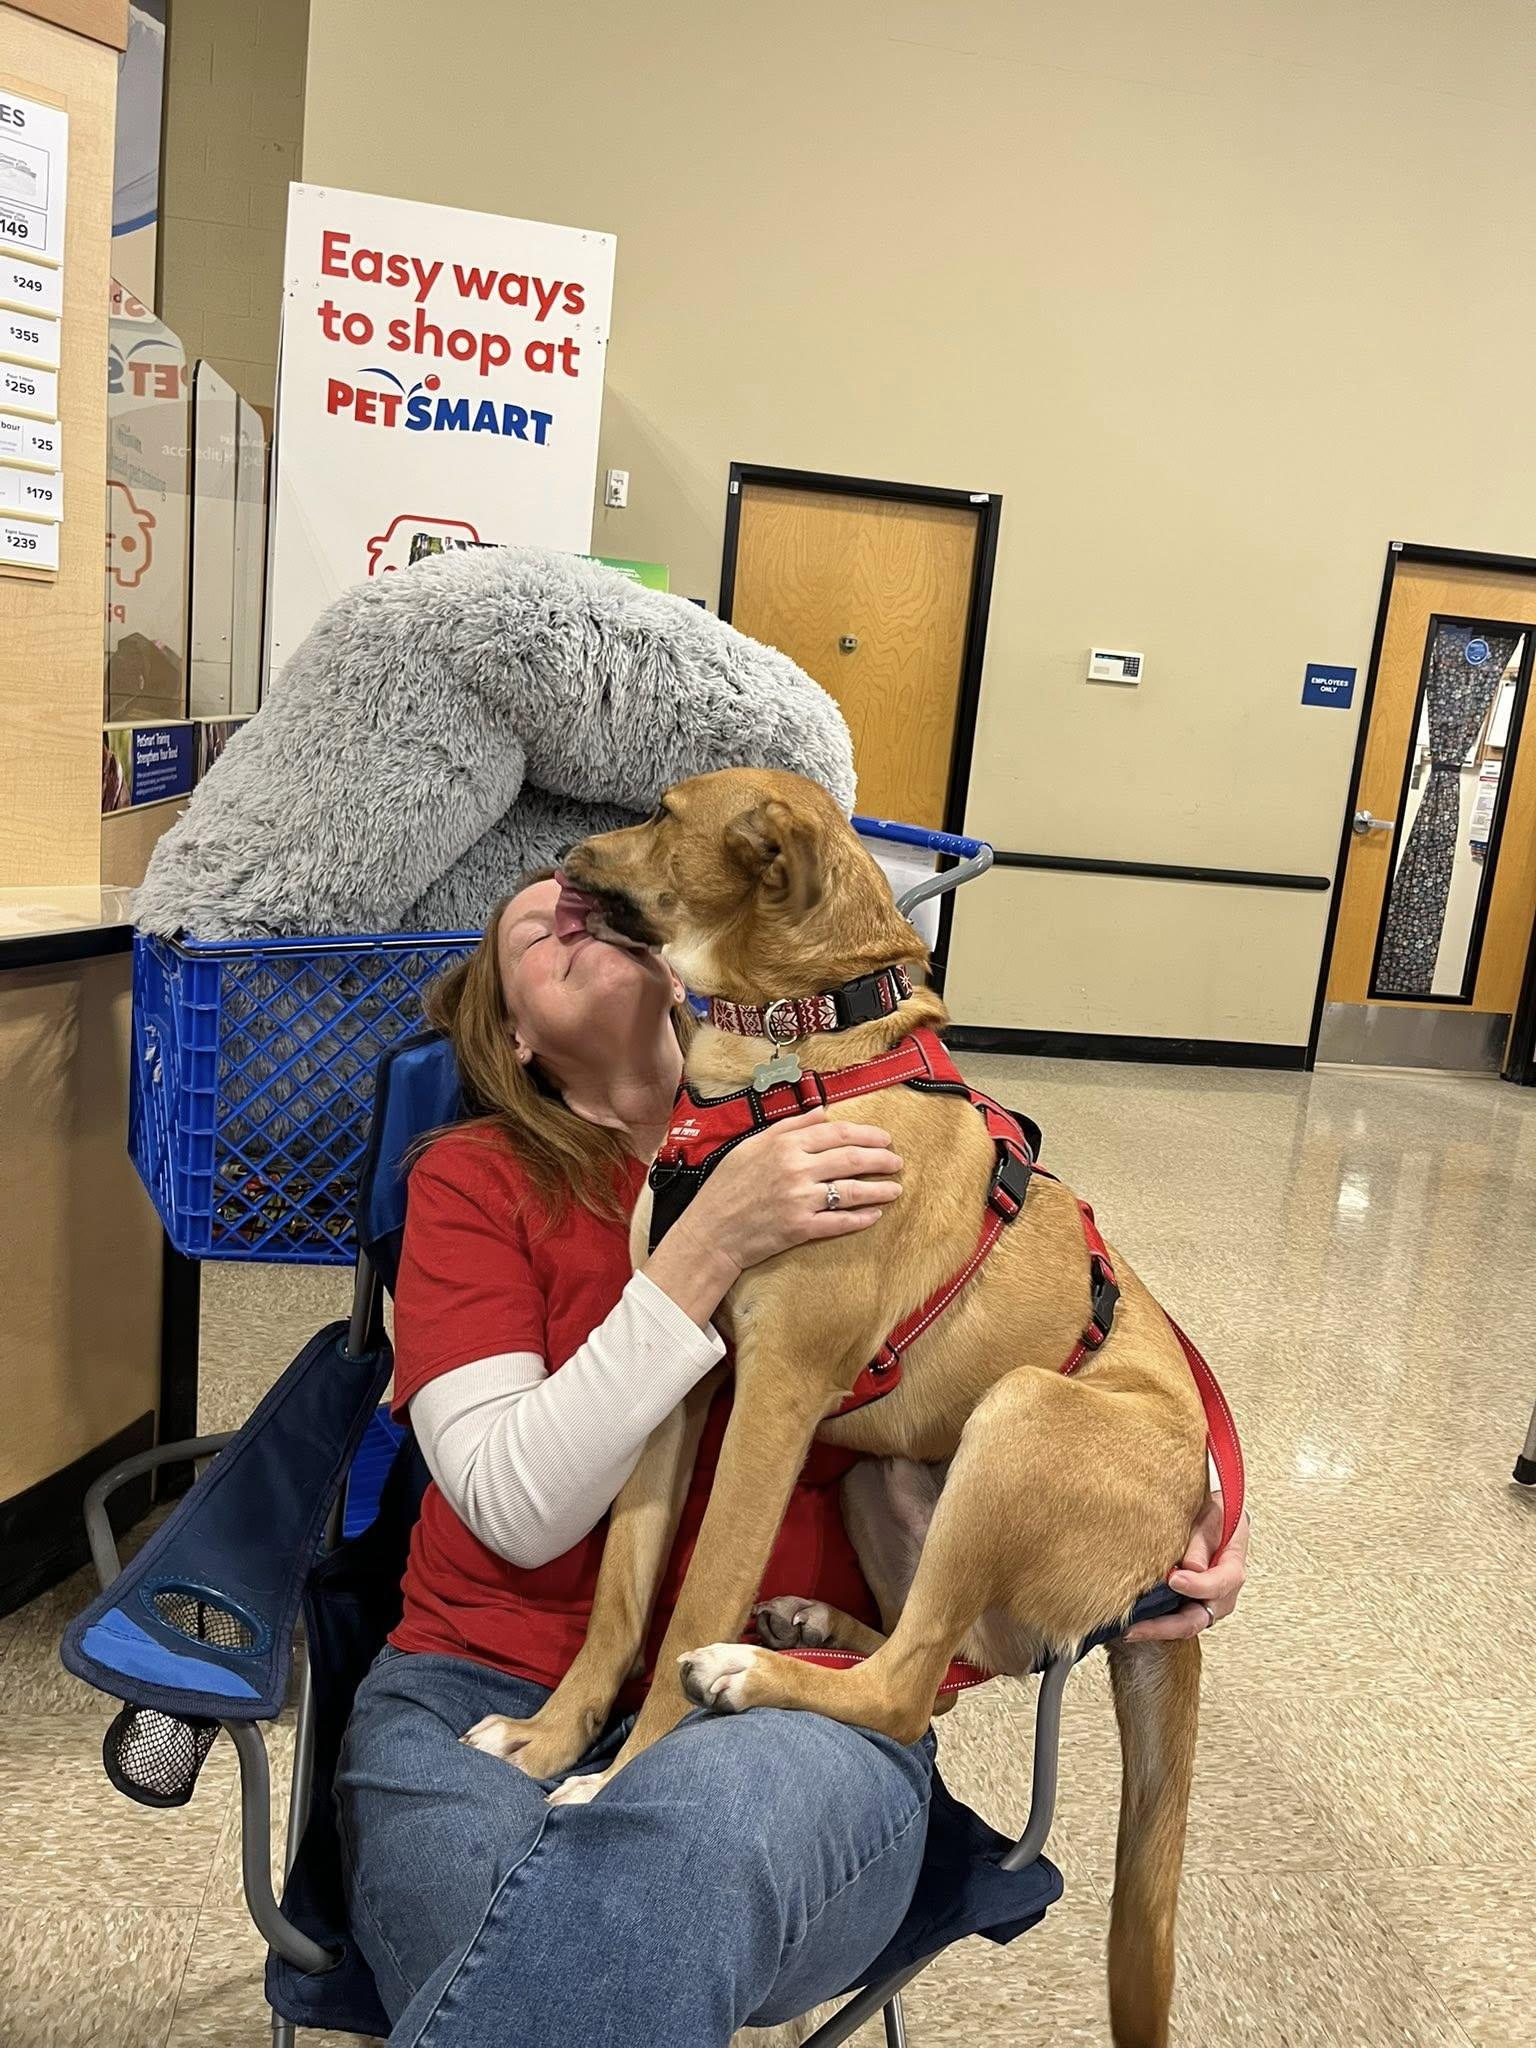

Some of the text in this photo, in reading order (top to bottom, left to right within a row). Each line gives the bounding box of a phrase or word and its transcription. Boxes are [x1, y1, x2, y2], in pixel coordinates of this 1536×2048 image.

[13, 275, 43, 293] $249
[321, 230, 585, 322] Easy ways
[10, 326, 39, 344] $355
[317, 299, 581, 378] to shop at
[5, 379, 36, 395] $259
[326, 376, 553, 446] PETSMART
[31, 437, 54, 451] $25
[26, 486, 53, 501] $179
[7, 535, 37, 550] $239
[1311, 677, 1349, 687] EMPLOYEES
